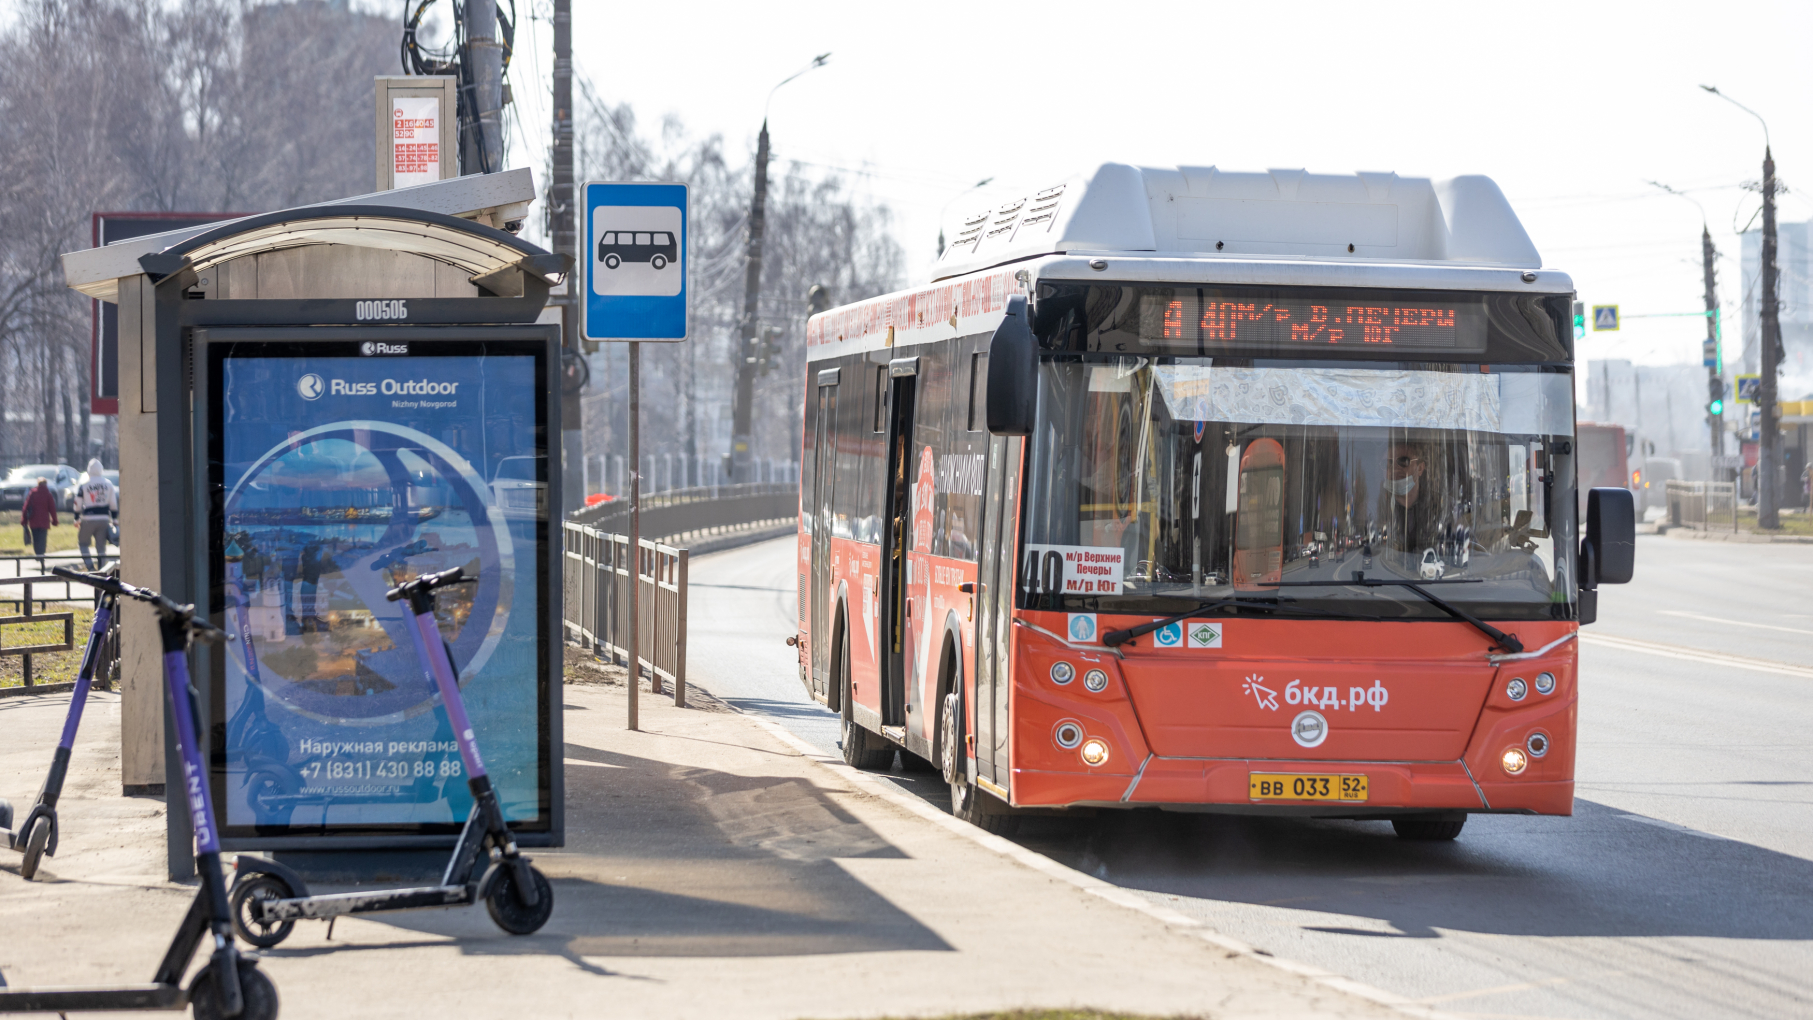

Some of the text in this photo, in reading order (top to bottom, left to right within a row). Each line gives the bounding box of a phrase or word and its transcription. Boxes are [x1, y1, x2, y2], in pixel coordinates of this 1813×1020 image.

[405, 120, 414, 128] 16
[415, 120, 424, 128] 40
[425, 120, 434, 128] 45
[395, 130, 414, 138] 52 90
[1200, 302, 1236, 339] 40
[376, 342, 408, 354] Russ
[331, 379, 458, 395] Russ Outdoor
[392, 400, 457, 409] Nizhny Novgorod
[1066, 550, 1122, 563] м/р Верхние
[1021, 550, 1064, 594] 40
[1076, 563, 1112, 576] Печеры
[1097, 579, 1117, 593] Юг
[1284, 679, 1389, 712] бкд.рф
[300, 739, 459, 757] Наружная реклама
[300, 760, 462, 780] +7 (831) 430 88 88
[300, 784, 400, 794] www.russoutdoor.ru
[1293, 778, 1330, 797] 033
[1342, 777, 1361, 792] 52
[184, 760, 211, 847] URENT
